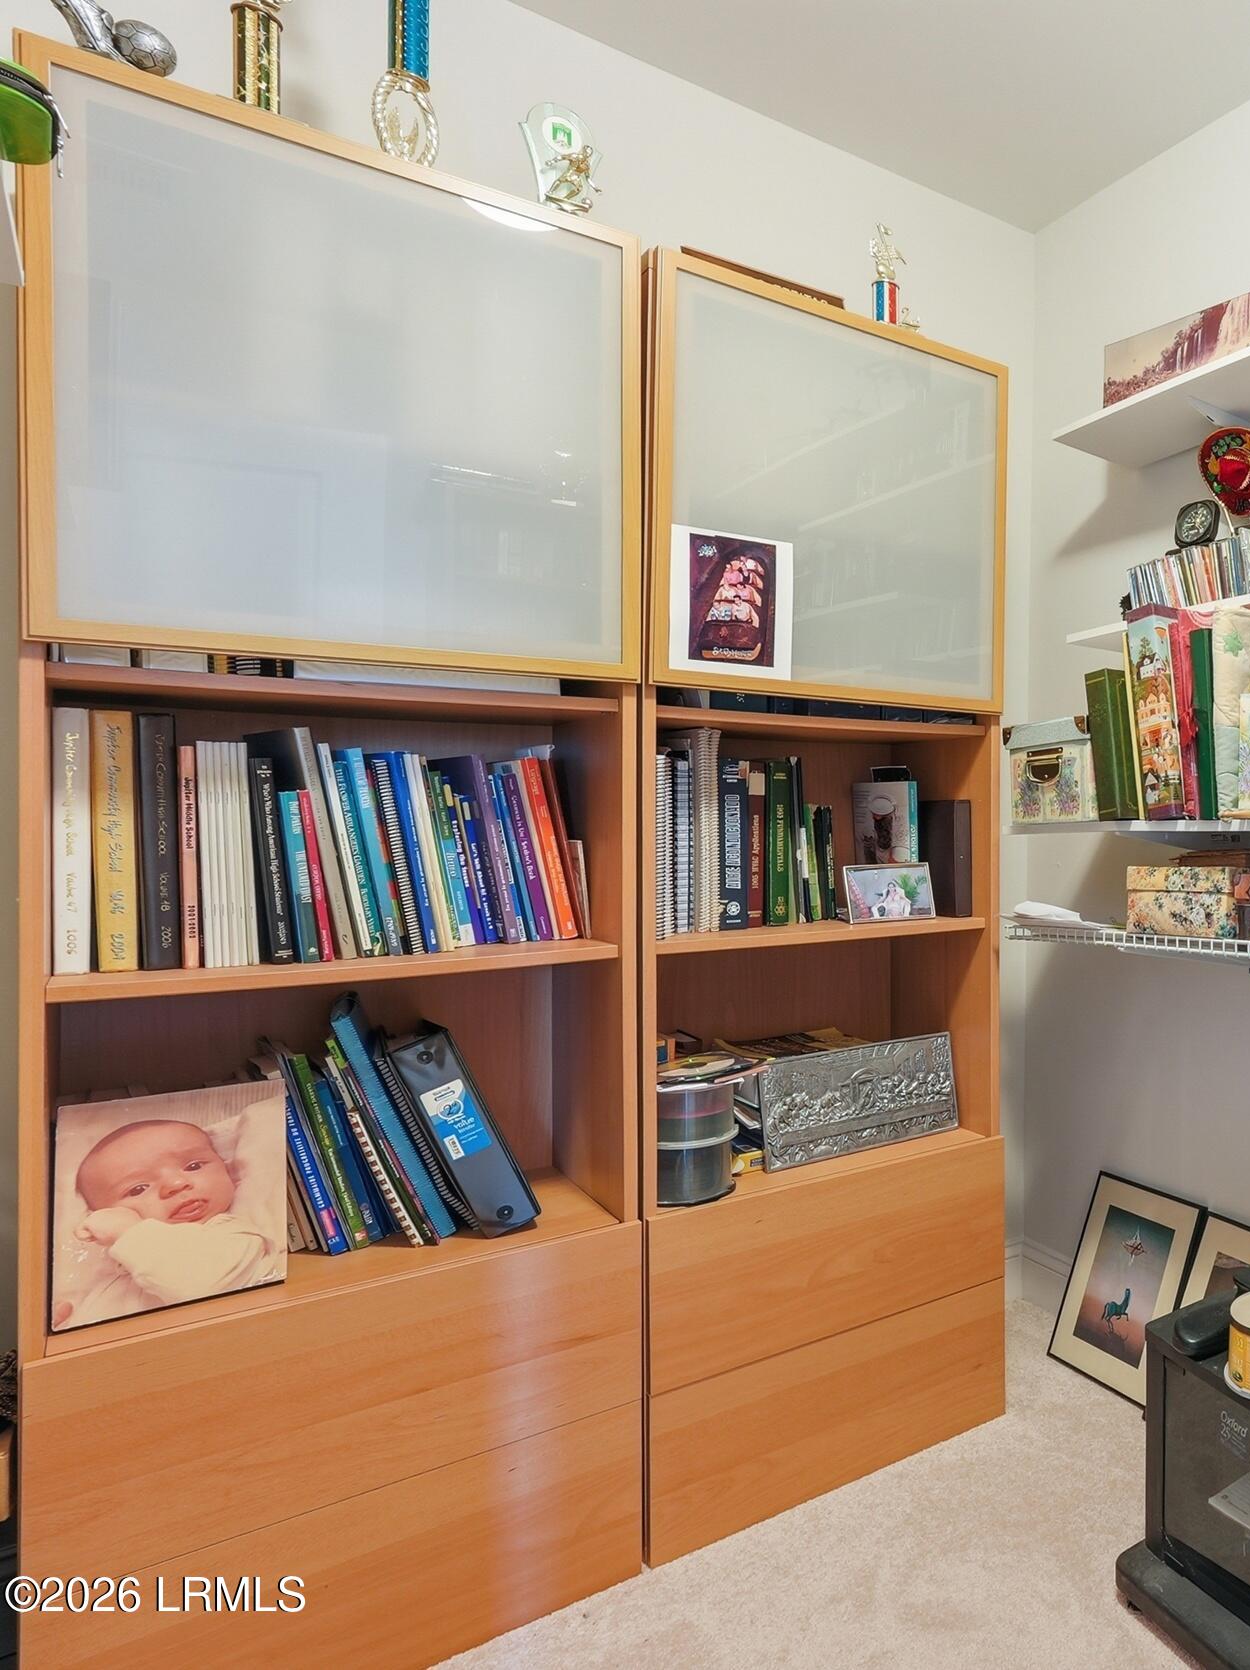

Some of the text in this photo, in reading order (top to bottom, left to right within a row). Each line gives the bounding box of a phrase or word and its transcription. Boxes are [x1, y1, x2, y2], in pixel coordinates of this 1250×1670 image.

[64, 732, 80, 761] Jupiter
[104, 724, 123, 761] Jupiter
[183, 776, 194, 801] Jupiter
[184, 802, 195, 826] Middle
[264, 813, 275, 834] Among
[185, 827, 195, 850] School
[265, 833, 277, 860] American
[336, 782, 350, 812] FLOWER
[352, 855, 367, 886] GARDEN
[751, 814, 760, 855] Applications
[776, 818, 785, 872] FUNDAMENTALS
[107, 843, 124, 874] School
[267, 859, 279, 873] High
[452, 819, 464, 854] Exploring
[460, 866, 471, 888] Issues
[270, 872, 281, 891] School
[475, 870, 485, 888] About
[1220, 1410, 1249, 1438] Oxford
[1220, 1422, 1232, 1440] 25
